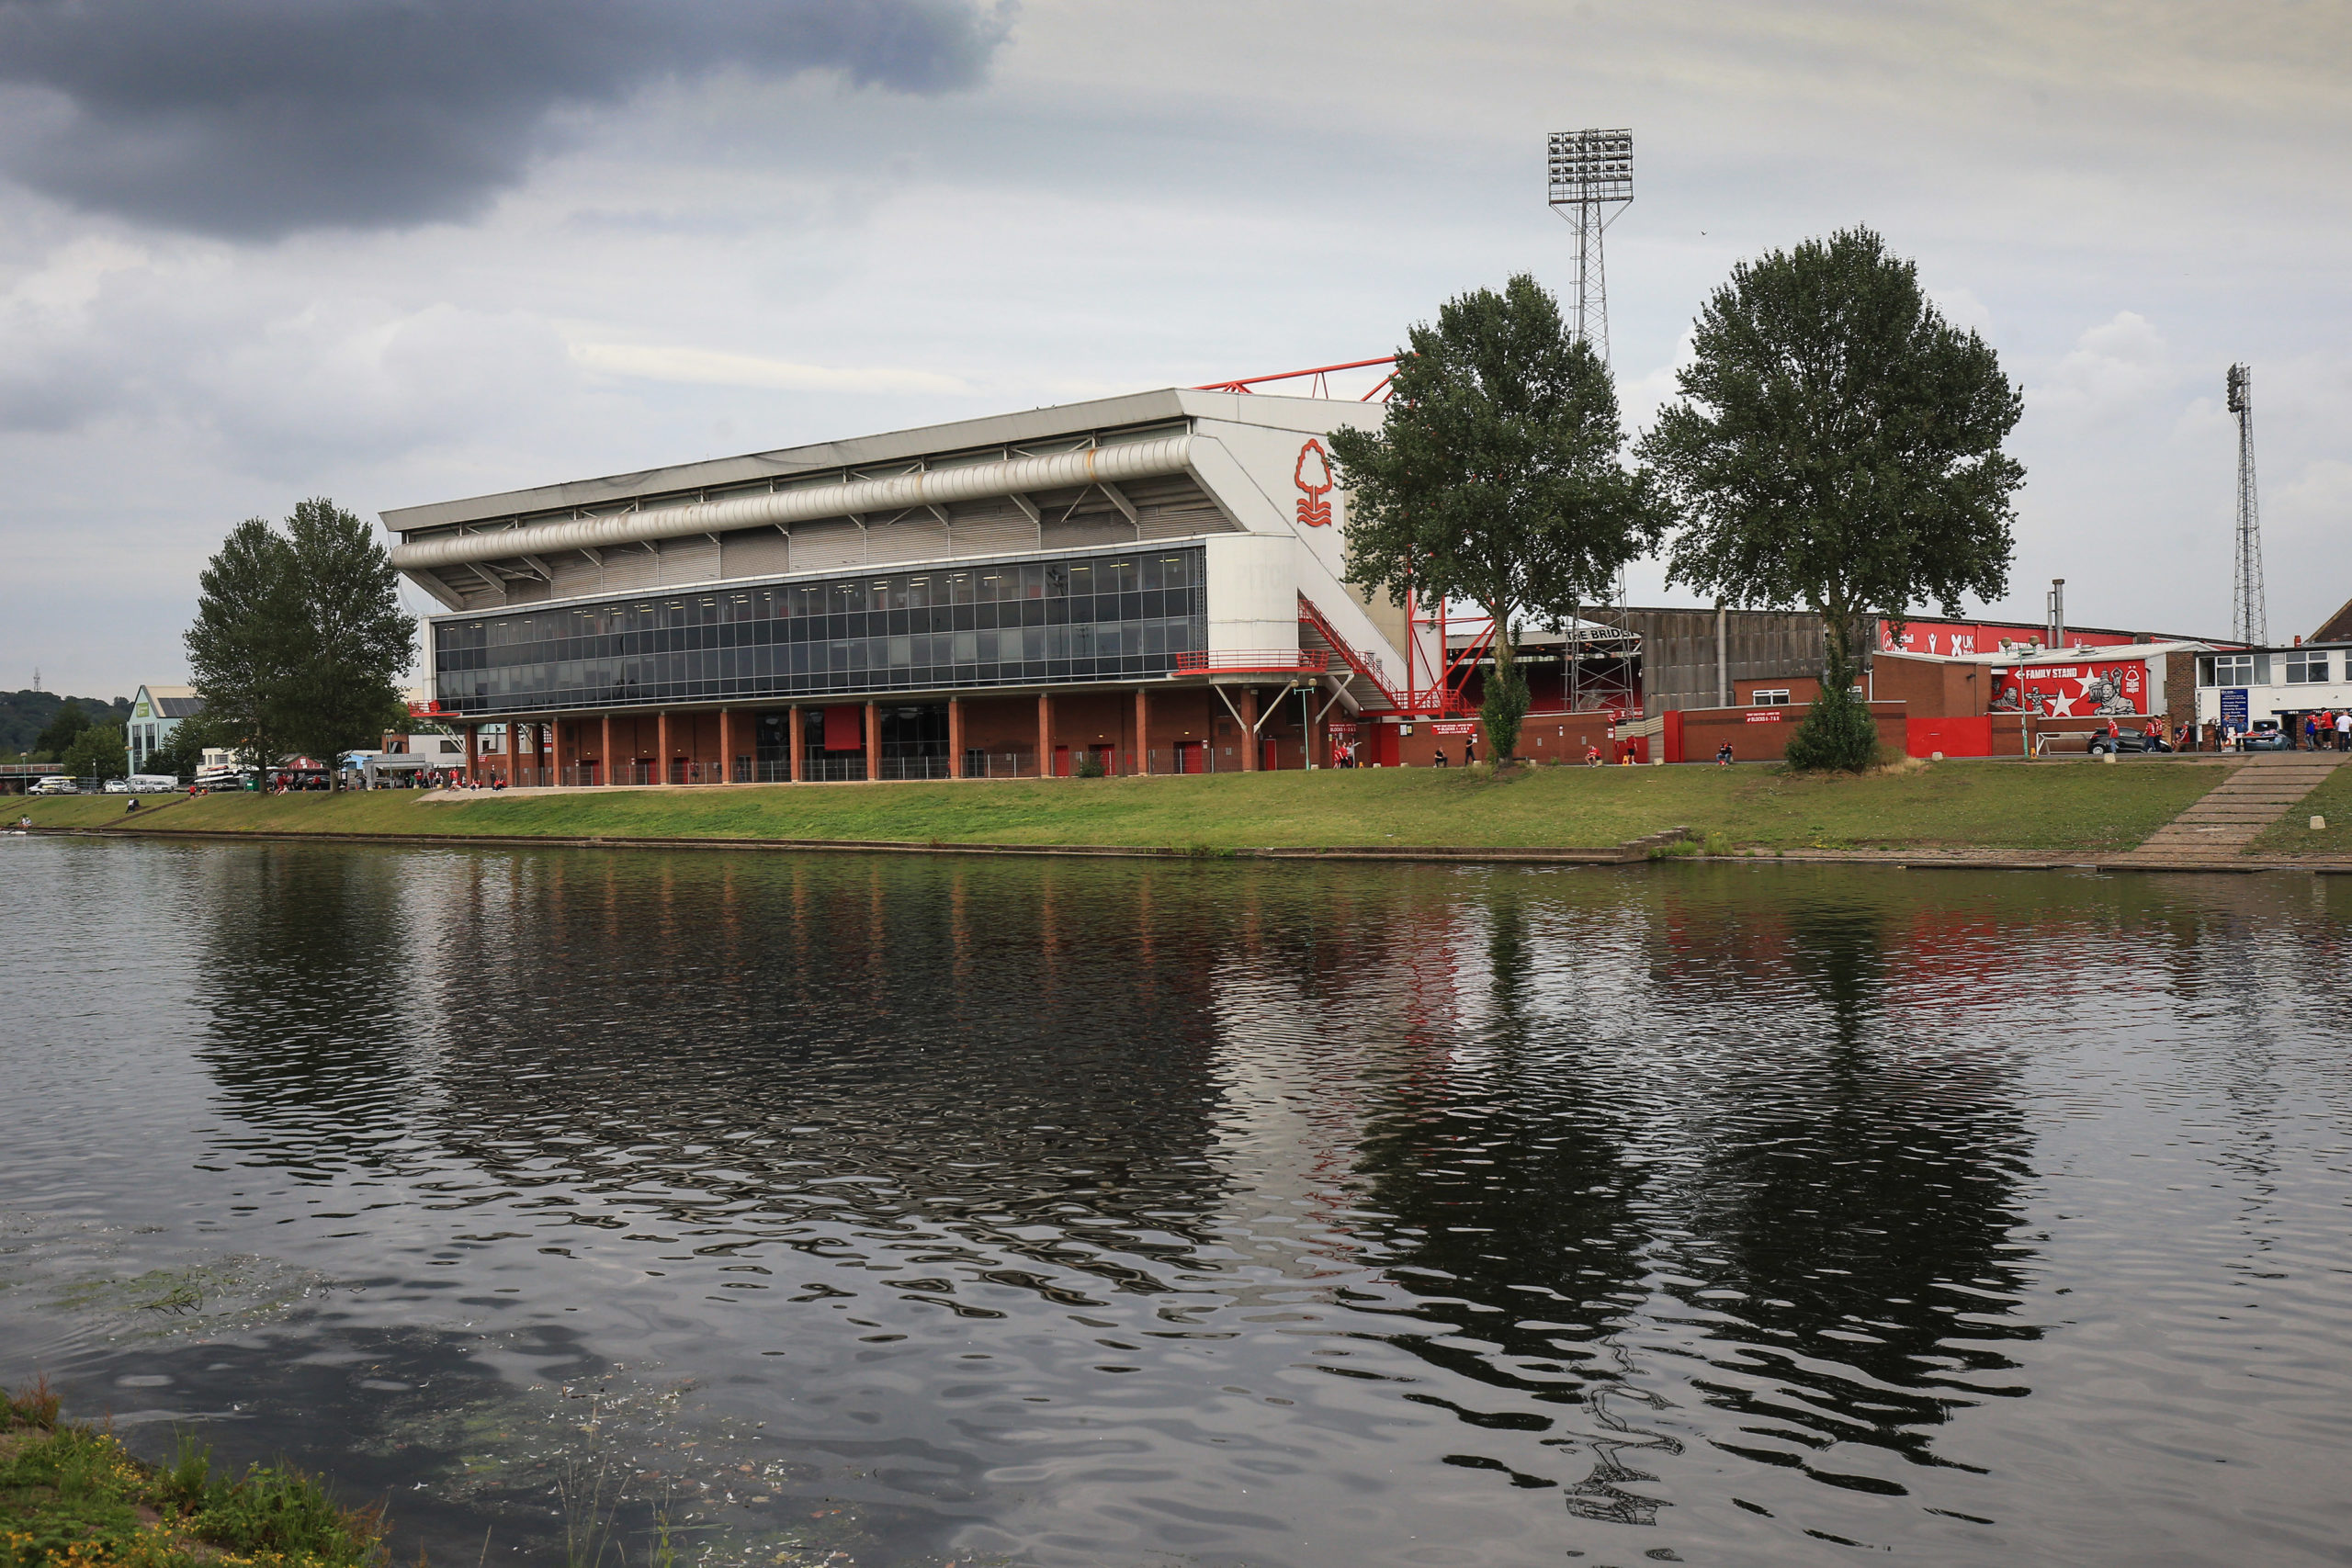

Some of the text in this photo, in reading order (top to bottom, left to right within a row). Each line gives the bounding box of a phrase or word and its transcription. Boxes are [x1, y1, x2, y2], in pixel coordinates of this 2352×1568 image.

[1962, 635, 1974, 649] UK
[2026, 668, 2077, 680] FAMILY STAND
